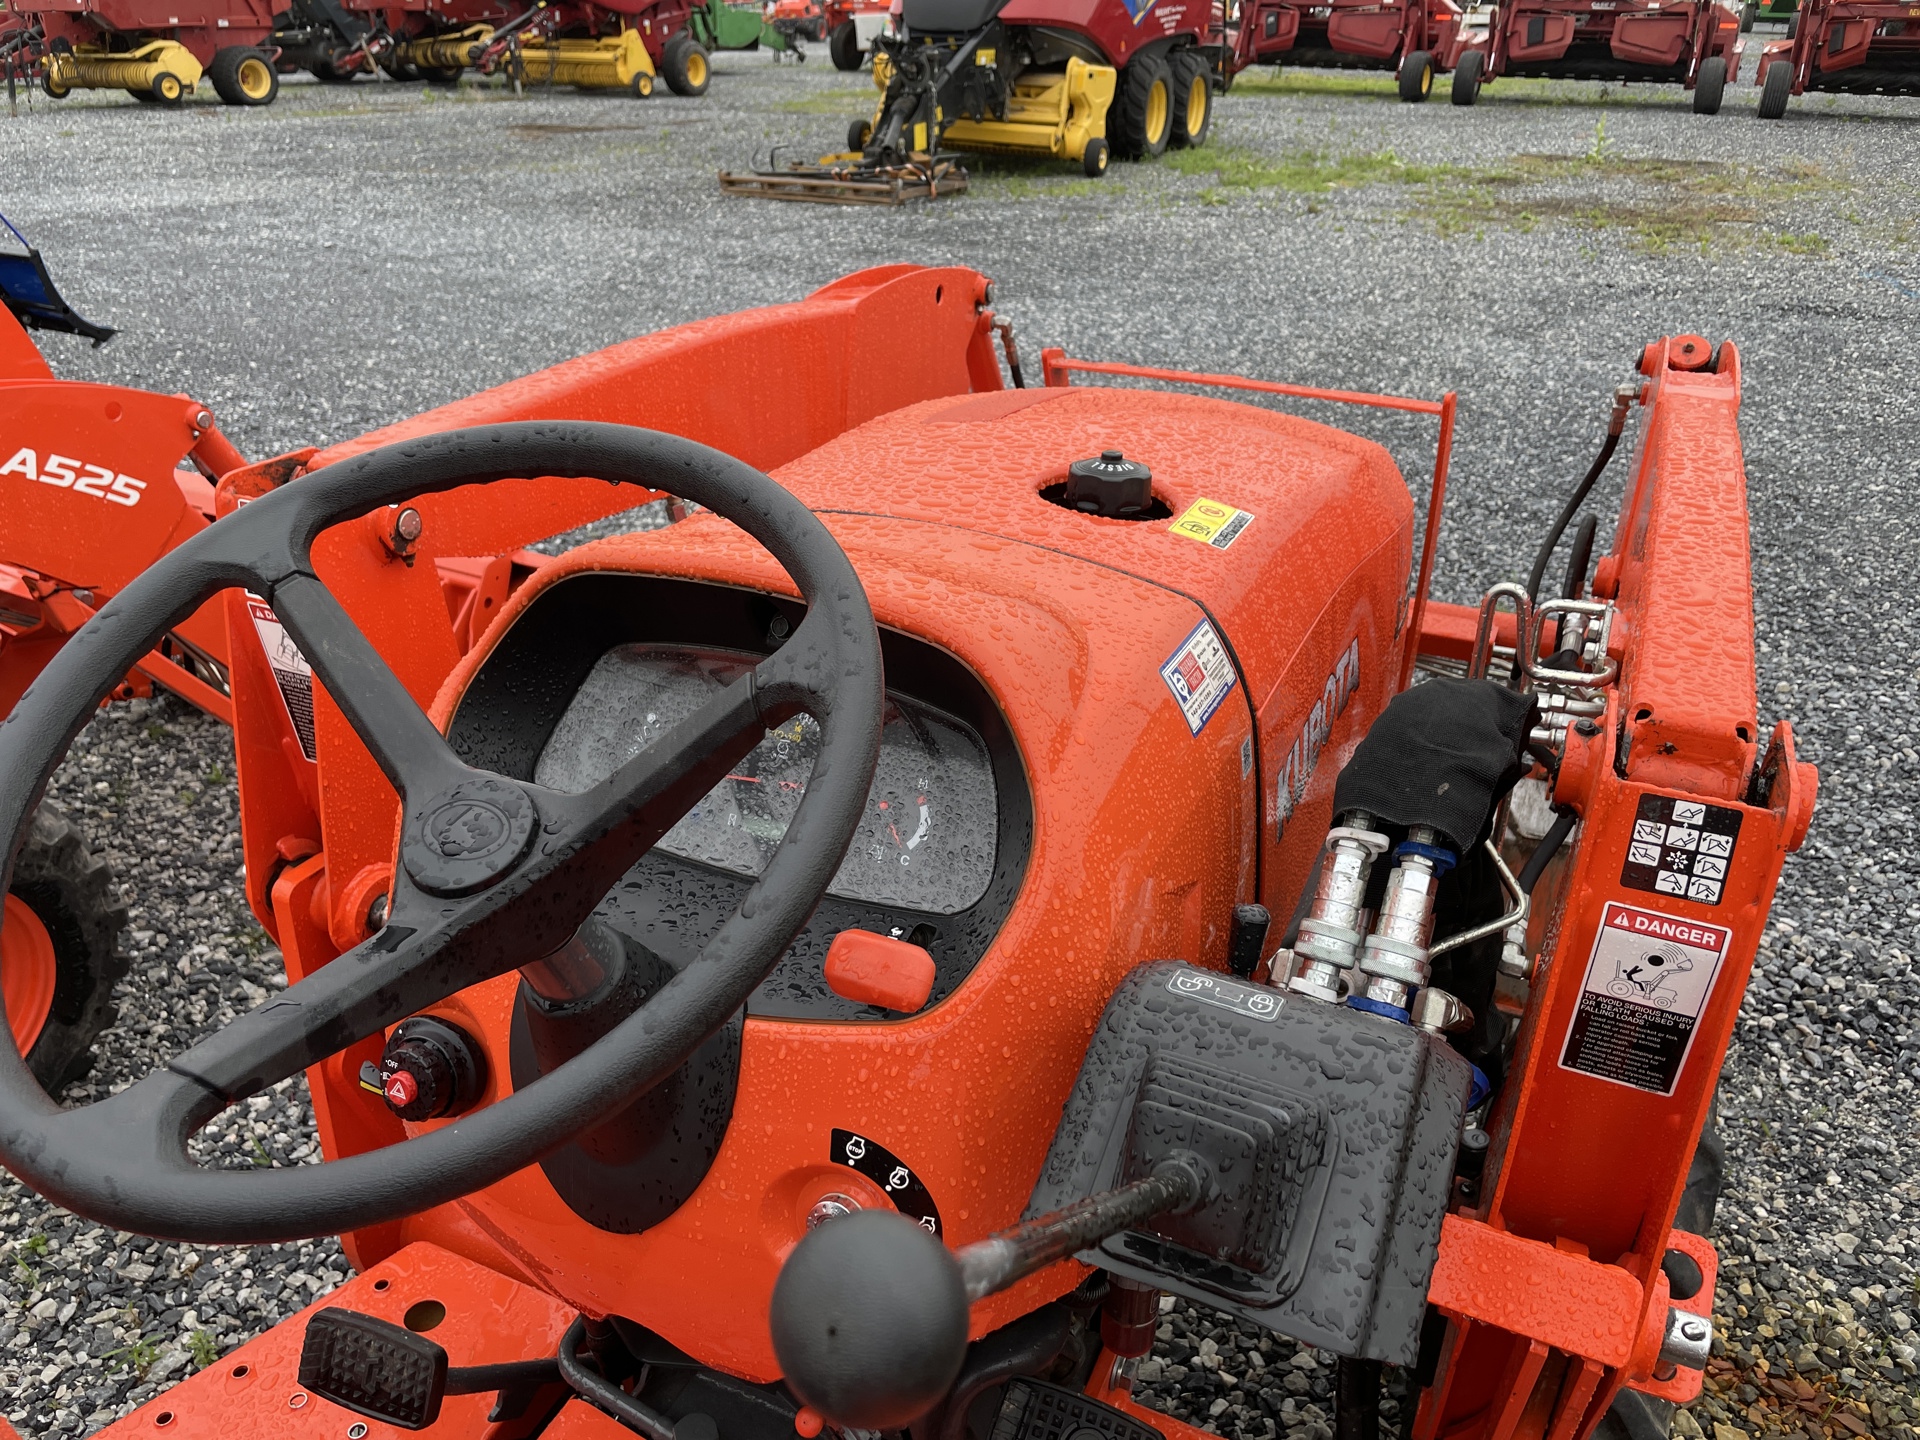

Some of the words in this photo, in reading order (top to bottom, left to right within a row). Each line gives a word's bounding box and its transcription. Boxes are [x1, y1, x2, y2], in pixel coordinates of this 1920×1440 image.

[1091, 461, 1134, 472] DIESEL
[1277, 635, 1360, 845] KUBOTA
[1634, 916, 1716, 946] DANGER
[1580, 1004, 1614, 1017] FALLING
[1597, 996, 1622, 1006] AVOID
[1624, 1003, 1661, 1016] SERIOUS
[1663, 1013, 1694, 1024] INJURY
[1601, 1004, 1630, 1015] DEATH
[1636, 1012, 1673, 1026] CAUSED
[1588, 1027, 1612, 1035] operator
[1614, 1034, 1637, 1042] causing
[1636, 1026, 1656, 1034] bucket
[1597, 1041, 1624, 1050] approved
[1626, 1048, 1652, 1058] clamping
[387, 1060, 398, 1069] OFF
[848, 1145, 862, 1154] STOP
